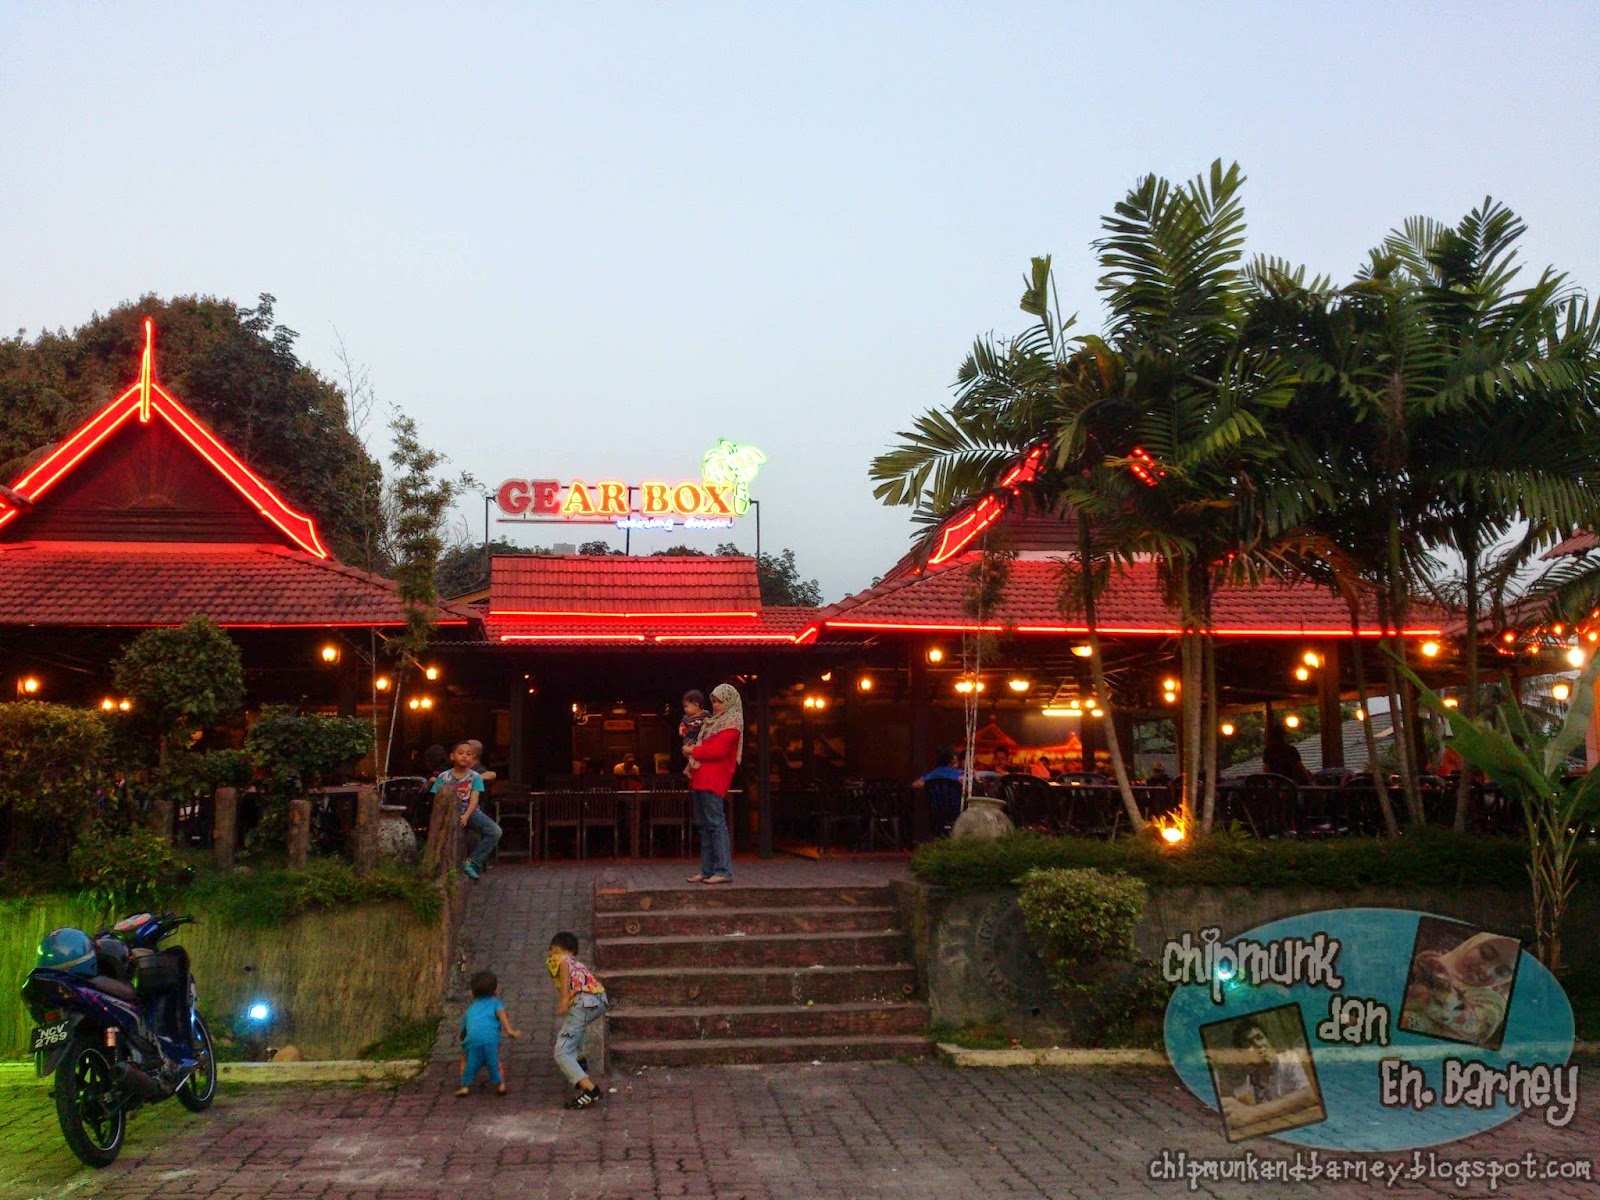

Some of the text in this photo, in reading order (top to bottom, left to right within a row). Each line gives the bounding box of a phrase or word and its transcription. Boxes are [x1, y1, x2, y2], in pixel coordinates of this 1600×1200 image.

[497, 478, 736, 517] GEAR BOX
[40, 1023, 65, 1038] NCV
[34, 1031, 67, 1049] 2769
